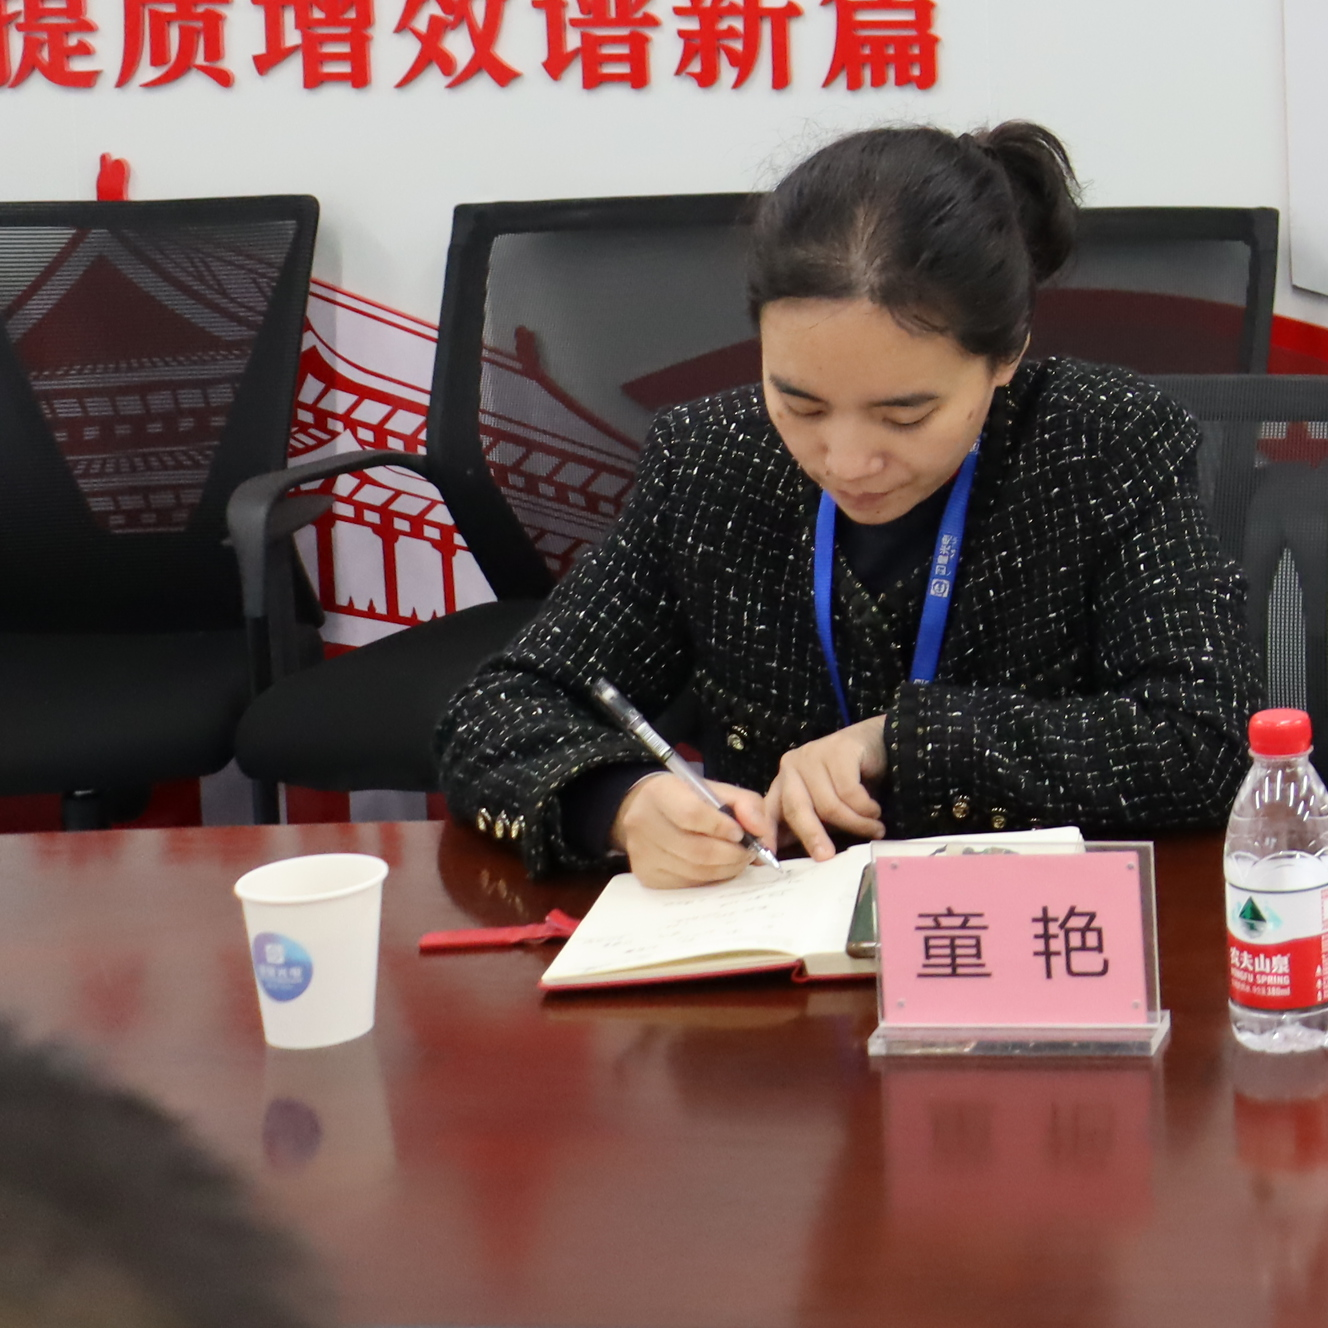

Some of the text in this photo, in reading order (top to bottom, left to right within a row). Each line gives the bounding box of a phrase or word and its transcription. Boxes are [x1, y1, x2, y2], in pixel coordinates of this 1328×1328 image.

[914, 904, 1110, 979] 童艳
[1230, 946, 1290, 974] 农夫山泉
[1256, 974, 1290, 986] SPRING
